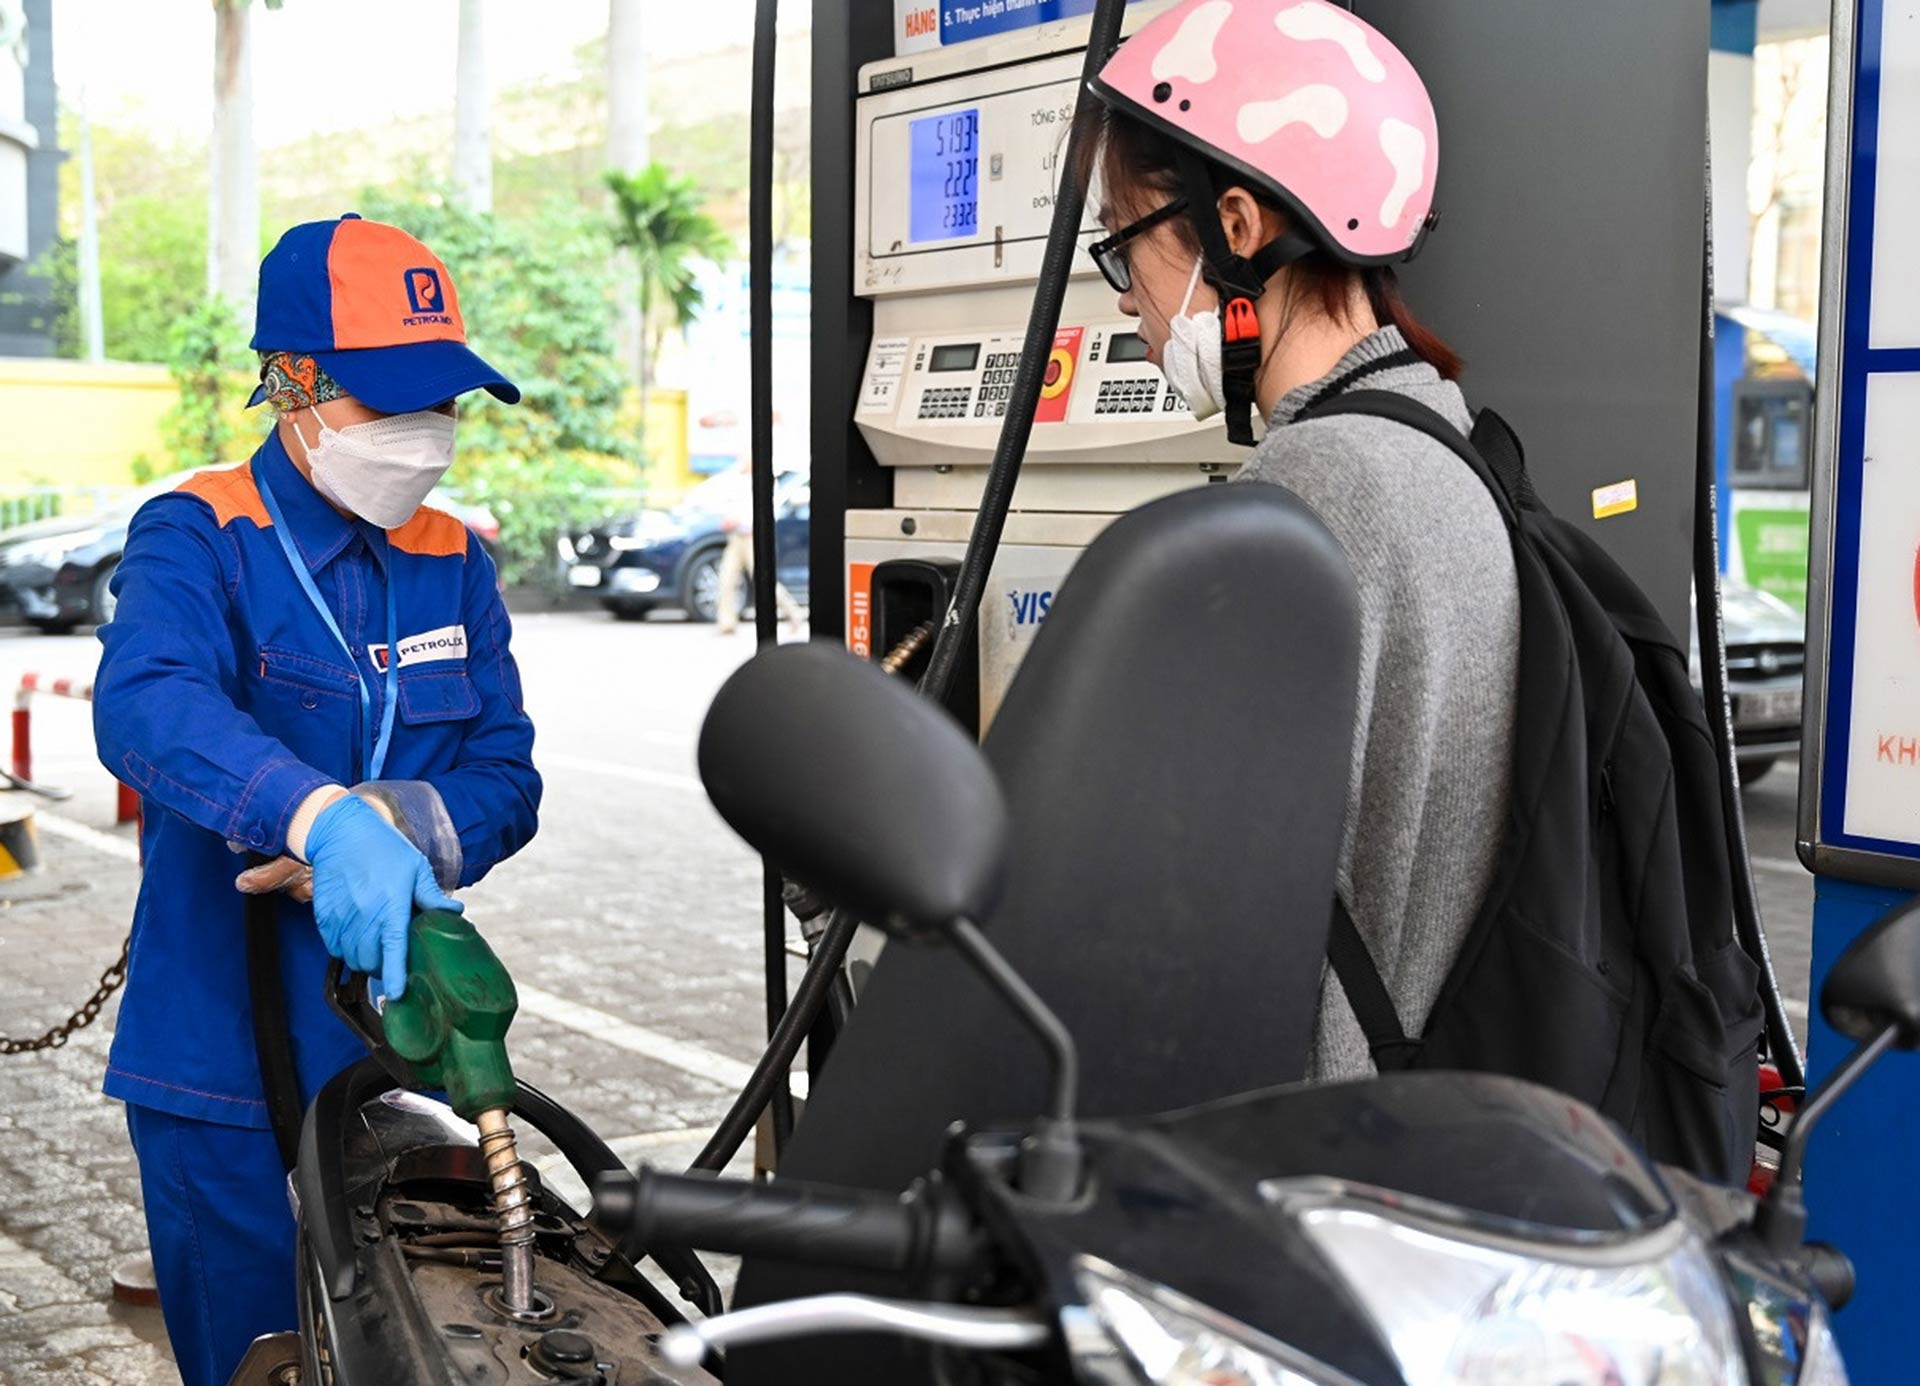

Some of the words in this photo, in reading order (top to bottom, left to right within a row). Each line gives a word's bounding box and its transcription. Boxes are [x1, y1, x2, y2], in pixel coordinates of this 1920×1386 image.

[905, 8, 936, 38] HÀNG
[1007, 590, 1053, 624] VIS
[1877, 735, 1920, 767] KH
